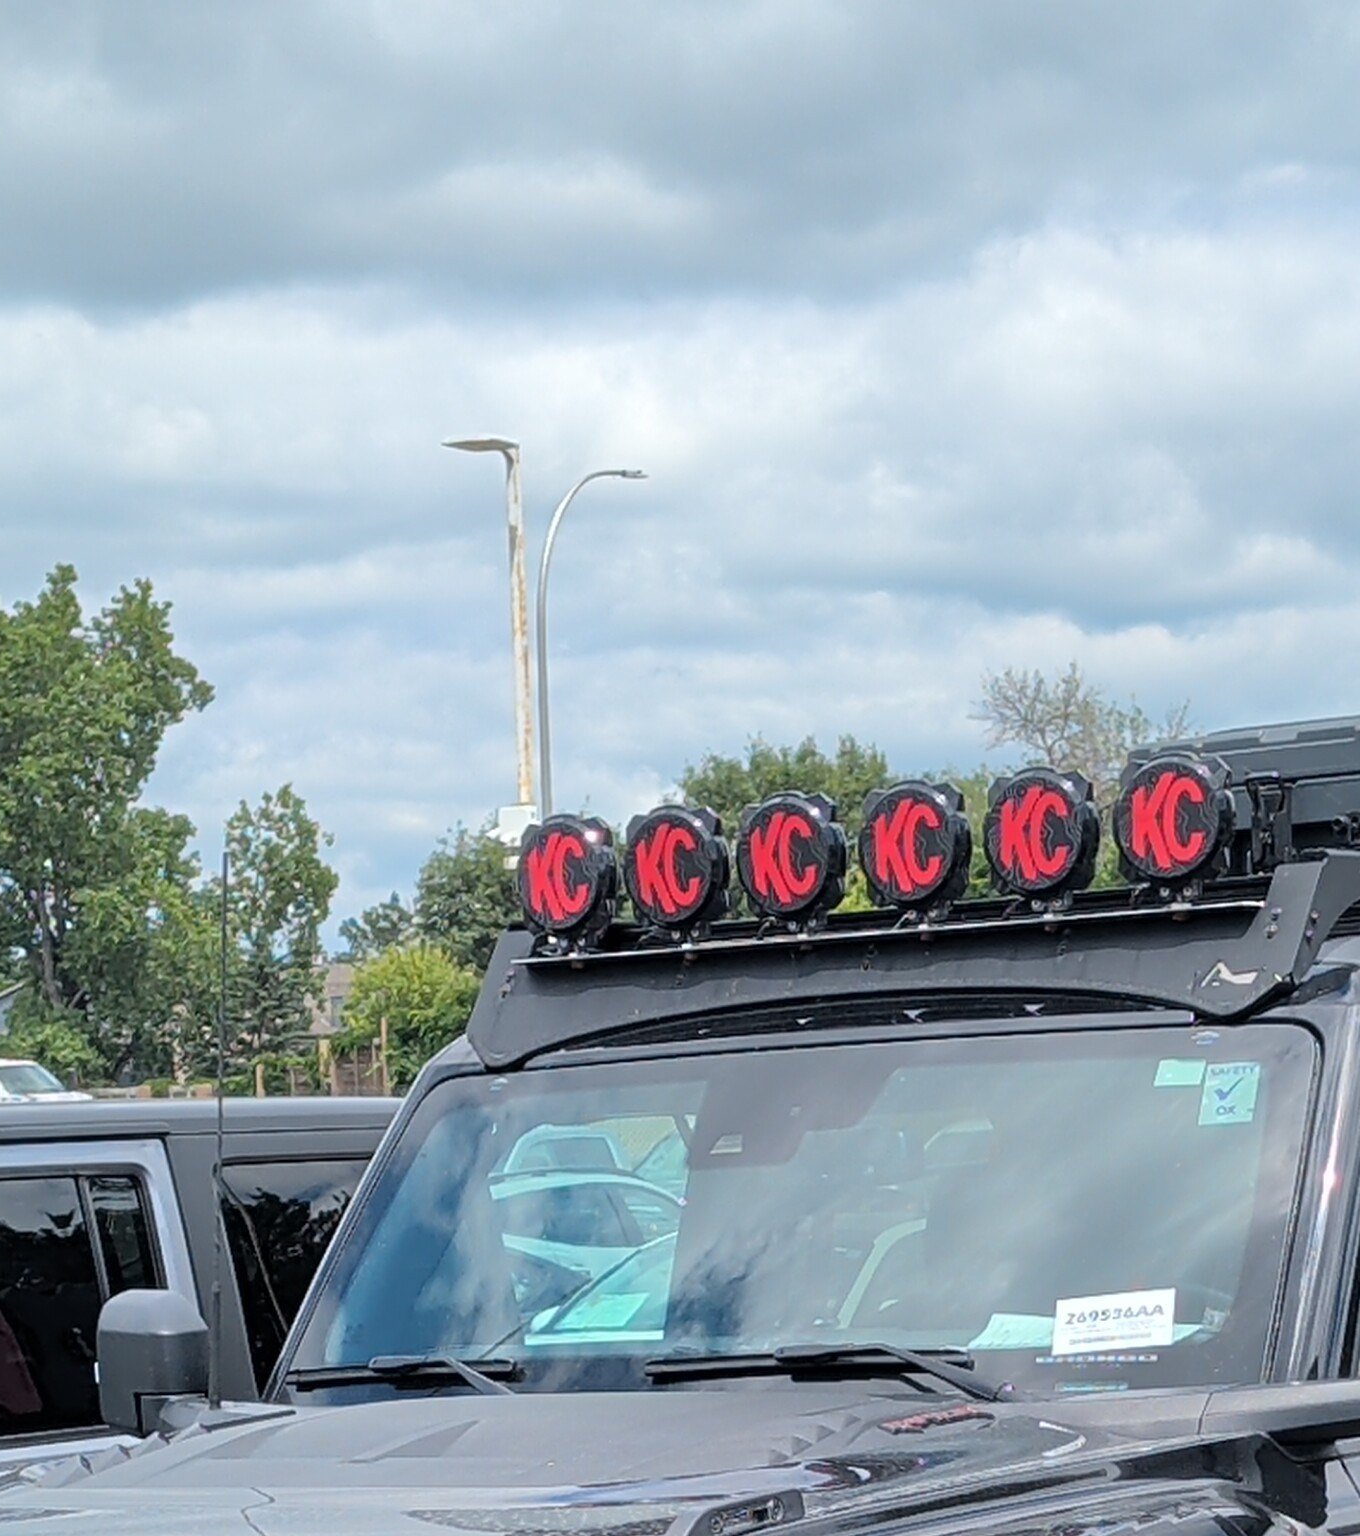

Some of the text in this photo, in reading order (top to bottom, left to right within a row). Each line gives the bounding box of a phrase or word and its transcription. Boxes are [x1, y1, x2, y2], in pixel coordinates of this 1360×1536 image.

[750, 811, 818, 904] KC
[873, 798, 942, 894] KC
[1001, 786, 1069, 881] KC
[1131, 771, 1206, 869] KC
[526, 831, 588, 921] KC
[635, 822, 700, 914] KC
